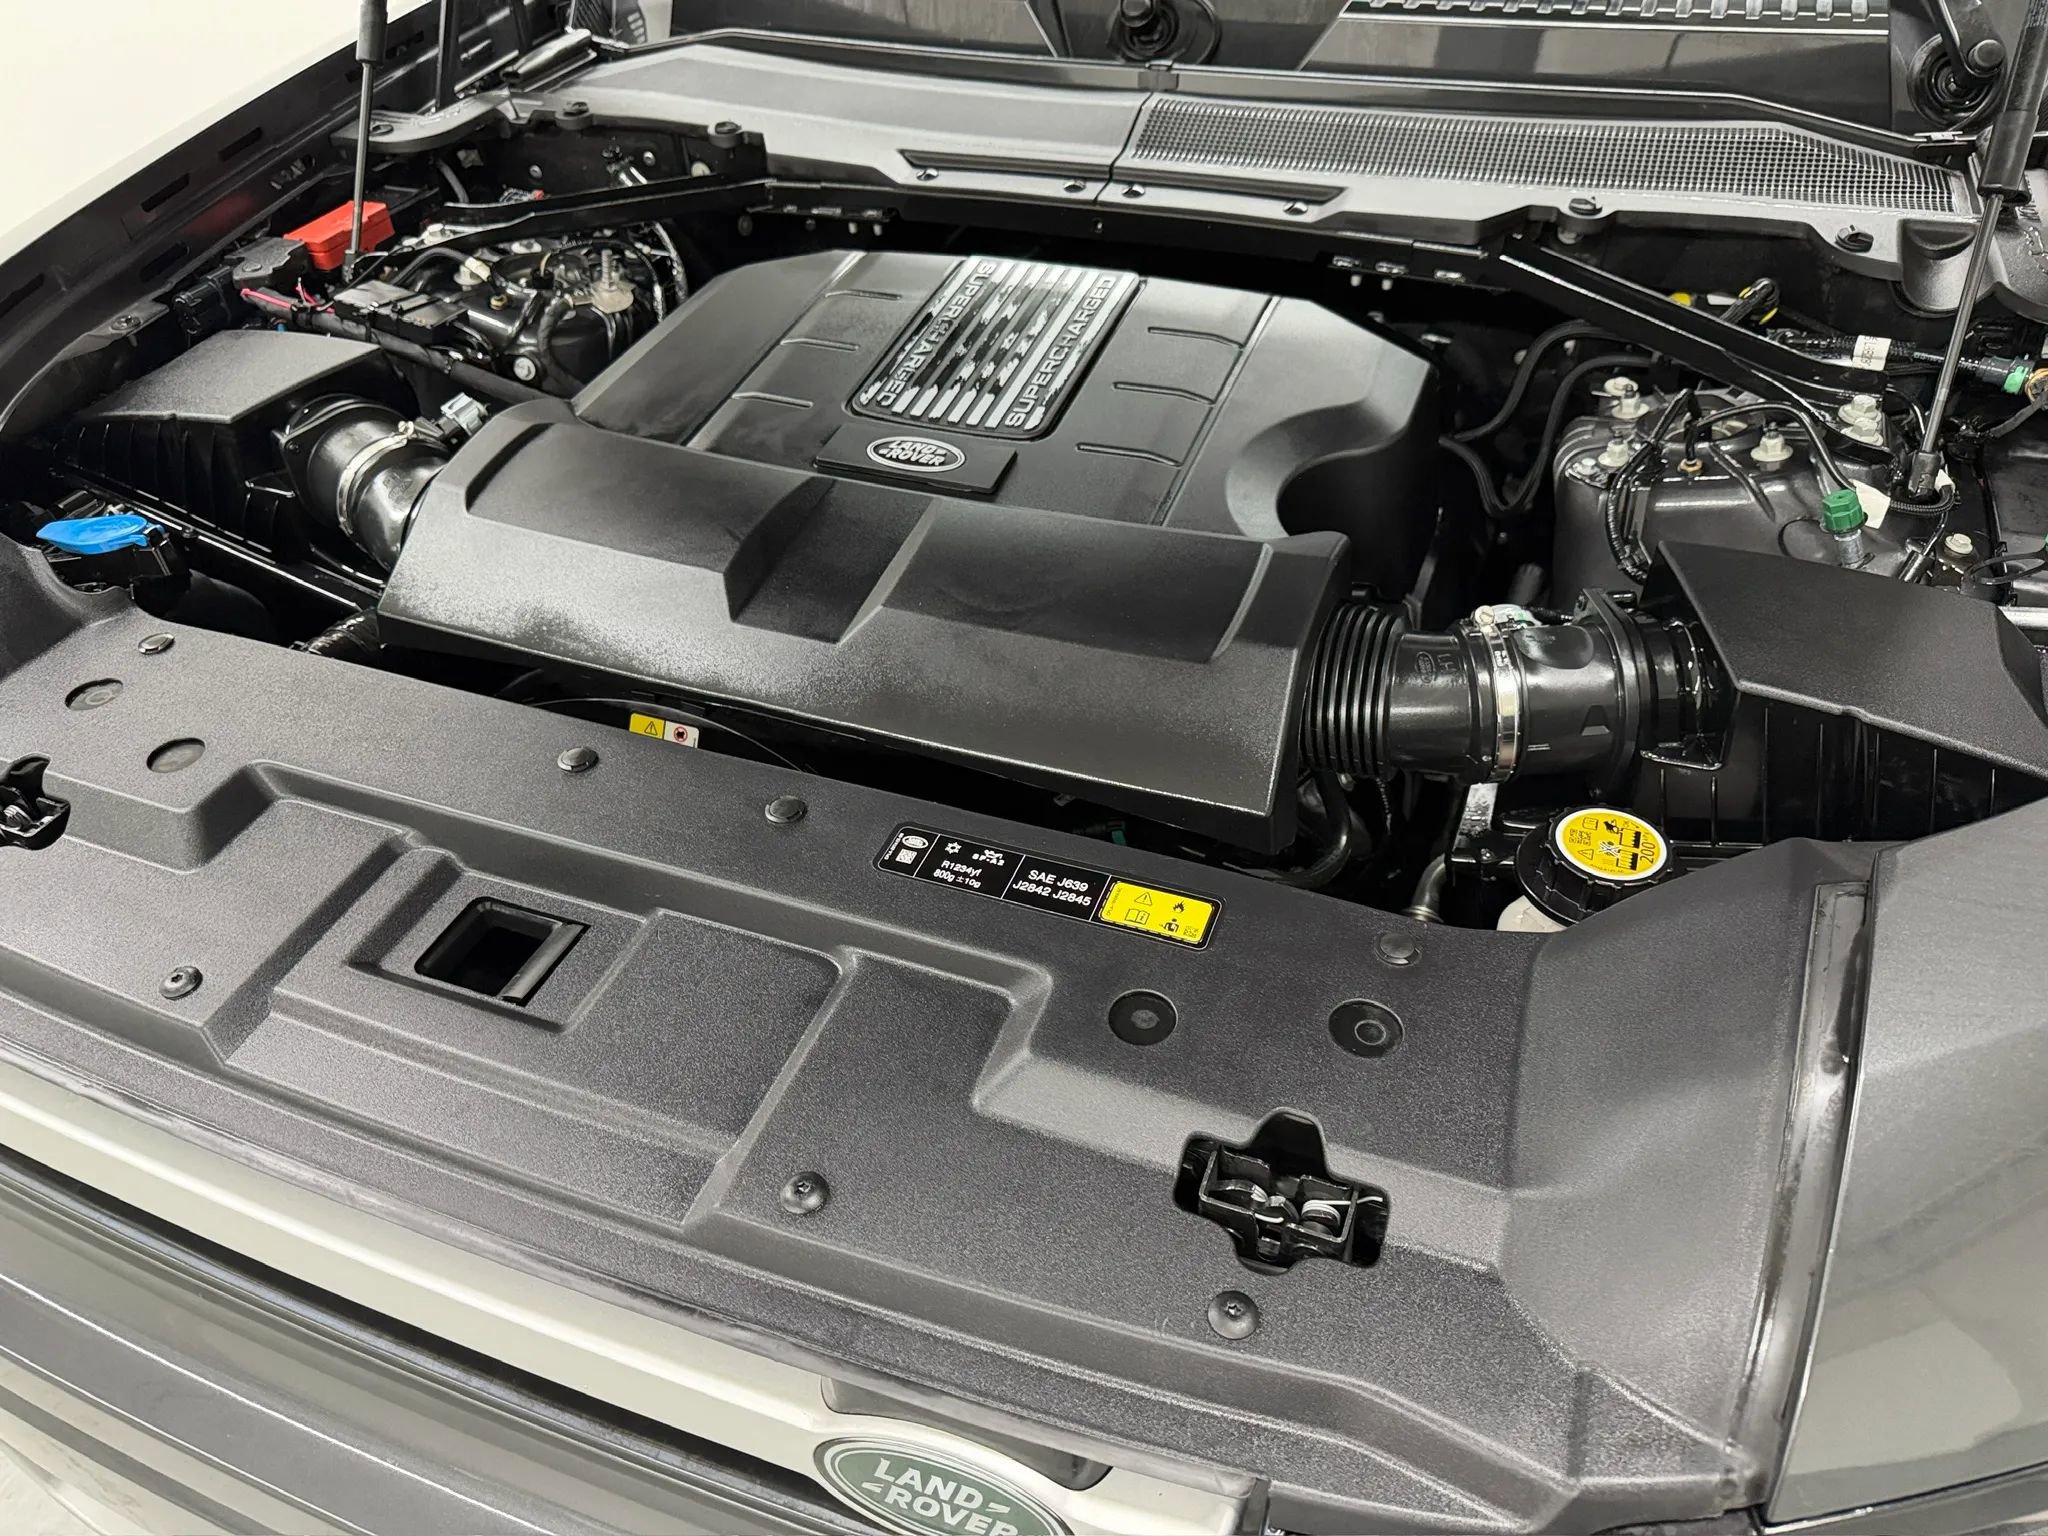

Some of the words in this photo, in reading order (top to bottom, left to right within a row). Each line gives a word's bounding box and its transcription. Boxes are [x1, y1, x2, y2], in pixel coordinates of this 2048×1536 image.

[1004, 275, 1116, 428] SUPERCHARGED
[886, 448, 945, 466] ROVER
[888, 440, 937, 455] LAND
[1640, 841, 1656, 864] 200
[933, 869, 955, 882] 800g
[940, 860, 982, 877] R1234yf
[1028, 869, 1056, 884] SAE
[1057, 878, 1089, 892] J639
[1012, 880, 1052, 897] J2842
[1052, 890, 1092, 906] J2845
[874, 1457, 984, 1509] LAND
[884, 1484, 1019, 1536] ROVER
